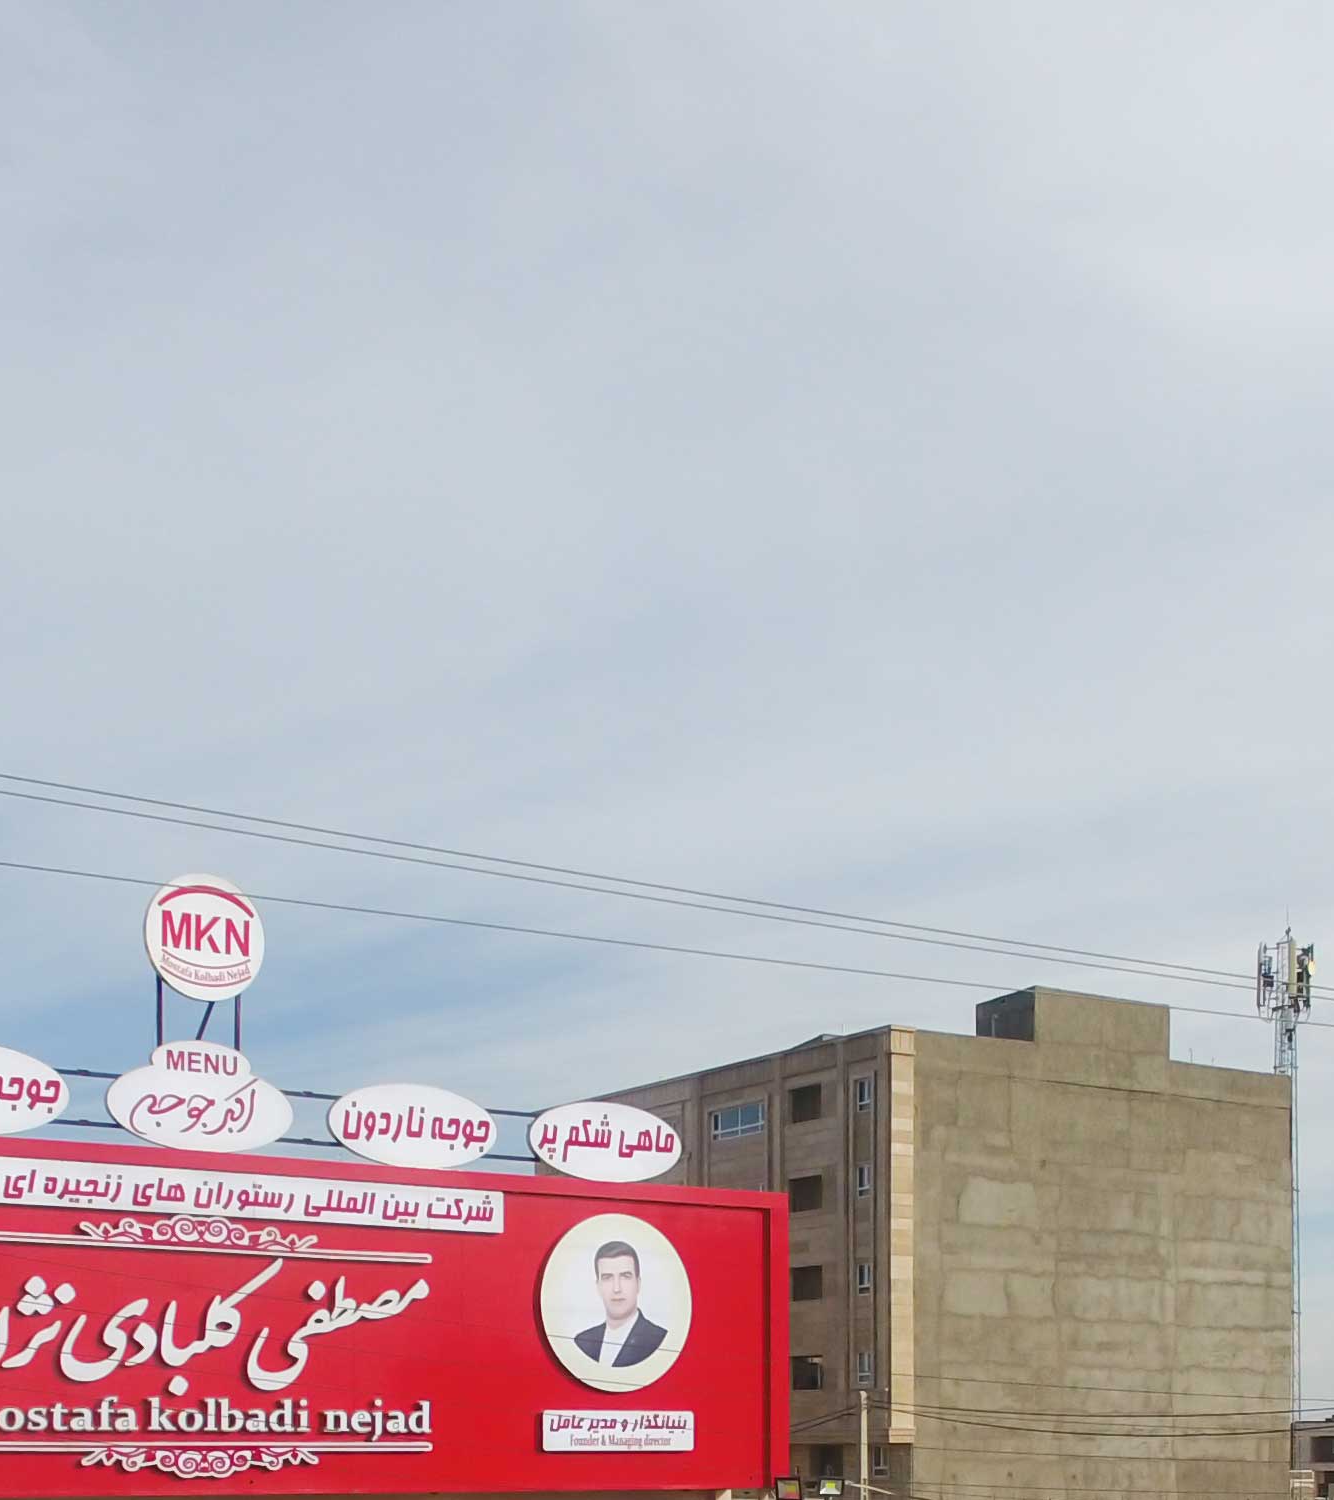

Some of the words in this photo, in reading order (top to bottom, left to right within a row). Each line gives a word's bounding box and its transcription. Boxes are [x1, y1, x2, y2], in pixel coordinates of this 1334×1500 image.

[161, 909, 251, 957] MKN
[167, 1049, 238, 1075] MENU
[342, 1101, 426, 1142] ناردون
[431, 1115, 491, 1152] جوجه
[538, 1122, 559, 1161] پر
[563, 1114, 613, 1162] شکم
[619, 1126, 675, 1158] ماهی
[3, 1169, 37, 1199] ای
[43, 1174, 123, 1204] زنجیره
[132, 1176, 185, 1206] های
[194, 1180, 295, 1215] رستوران
[303, 1188, 376, 1217] المللی
[382, 1193, 419, 1224] بین
[427, 1194, 494, 1225] شرکت
[60, 1258, 284, 1396] کلبادی
[247, 1276, 430, 1391] مصطفی
[147, 1397, 312, 1434] kolbadi
[323, 1399, 432, 1441] nejad
[549, 1415, 585, 1432] عامل
[587, 1418, 617, 1433] مدیر
[620, 1419, 629, 1432] و
[632, 1414, 687, 1434] بنیانگذار
